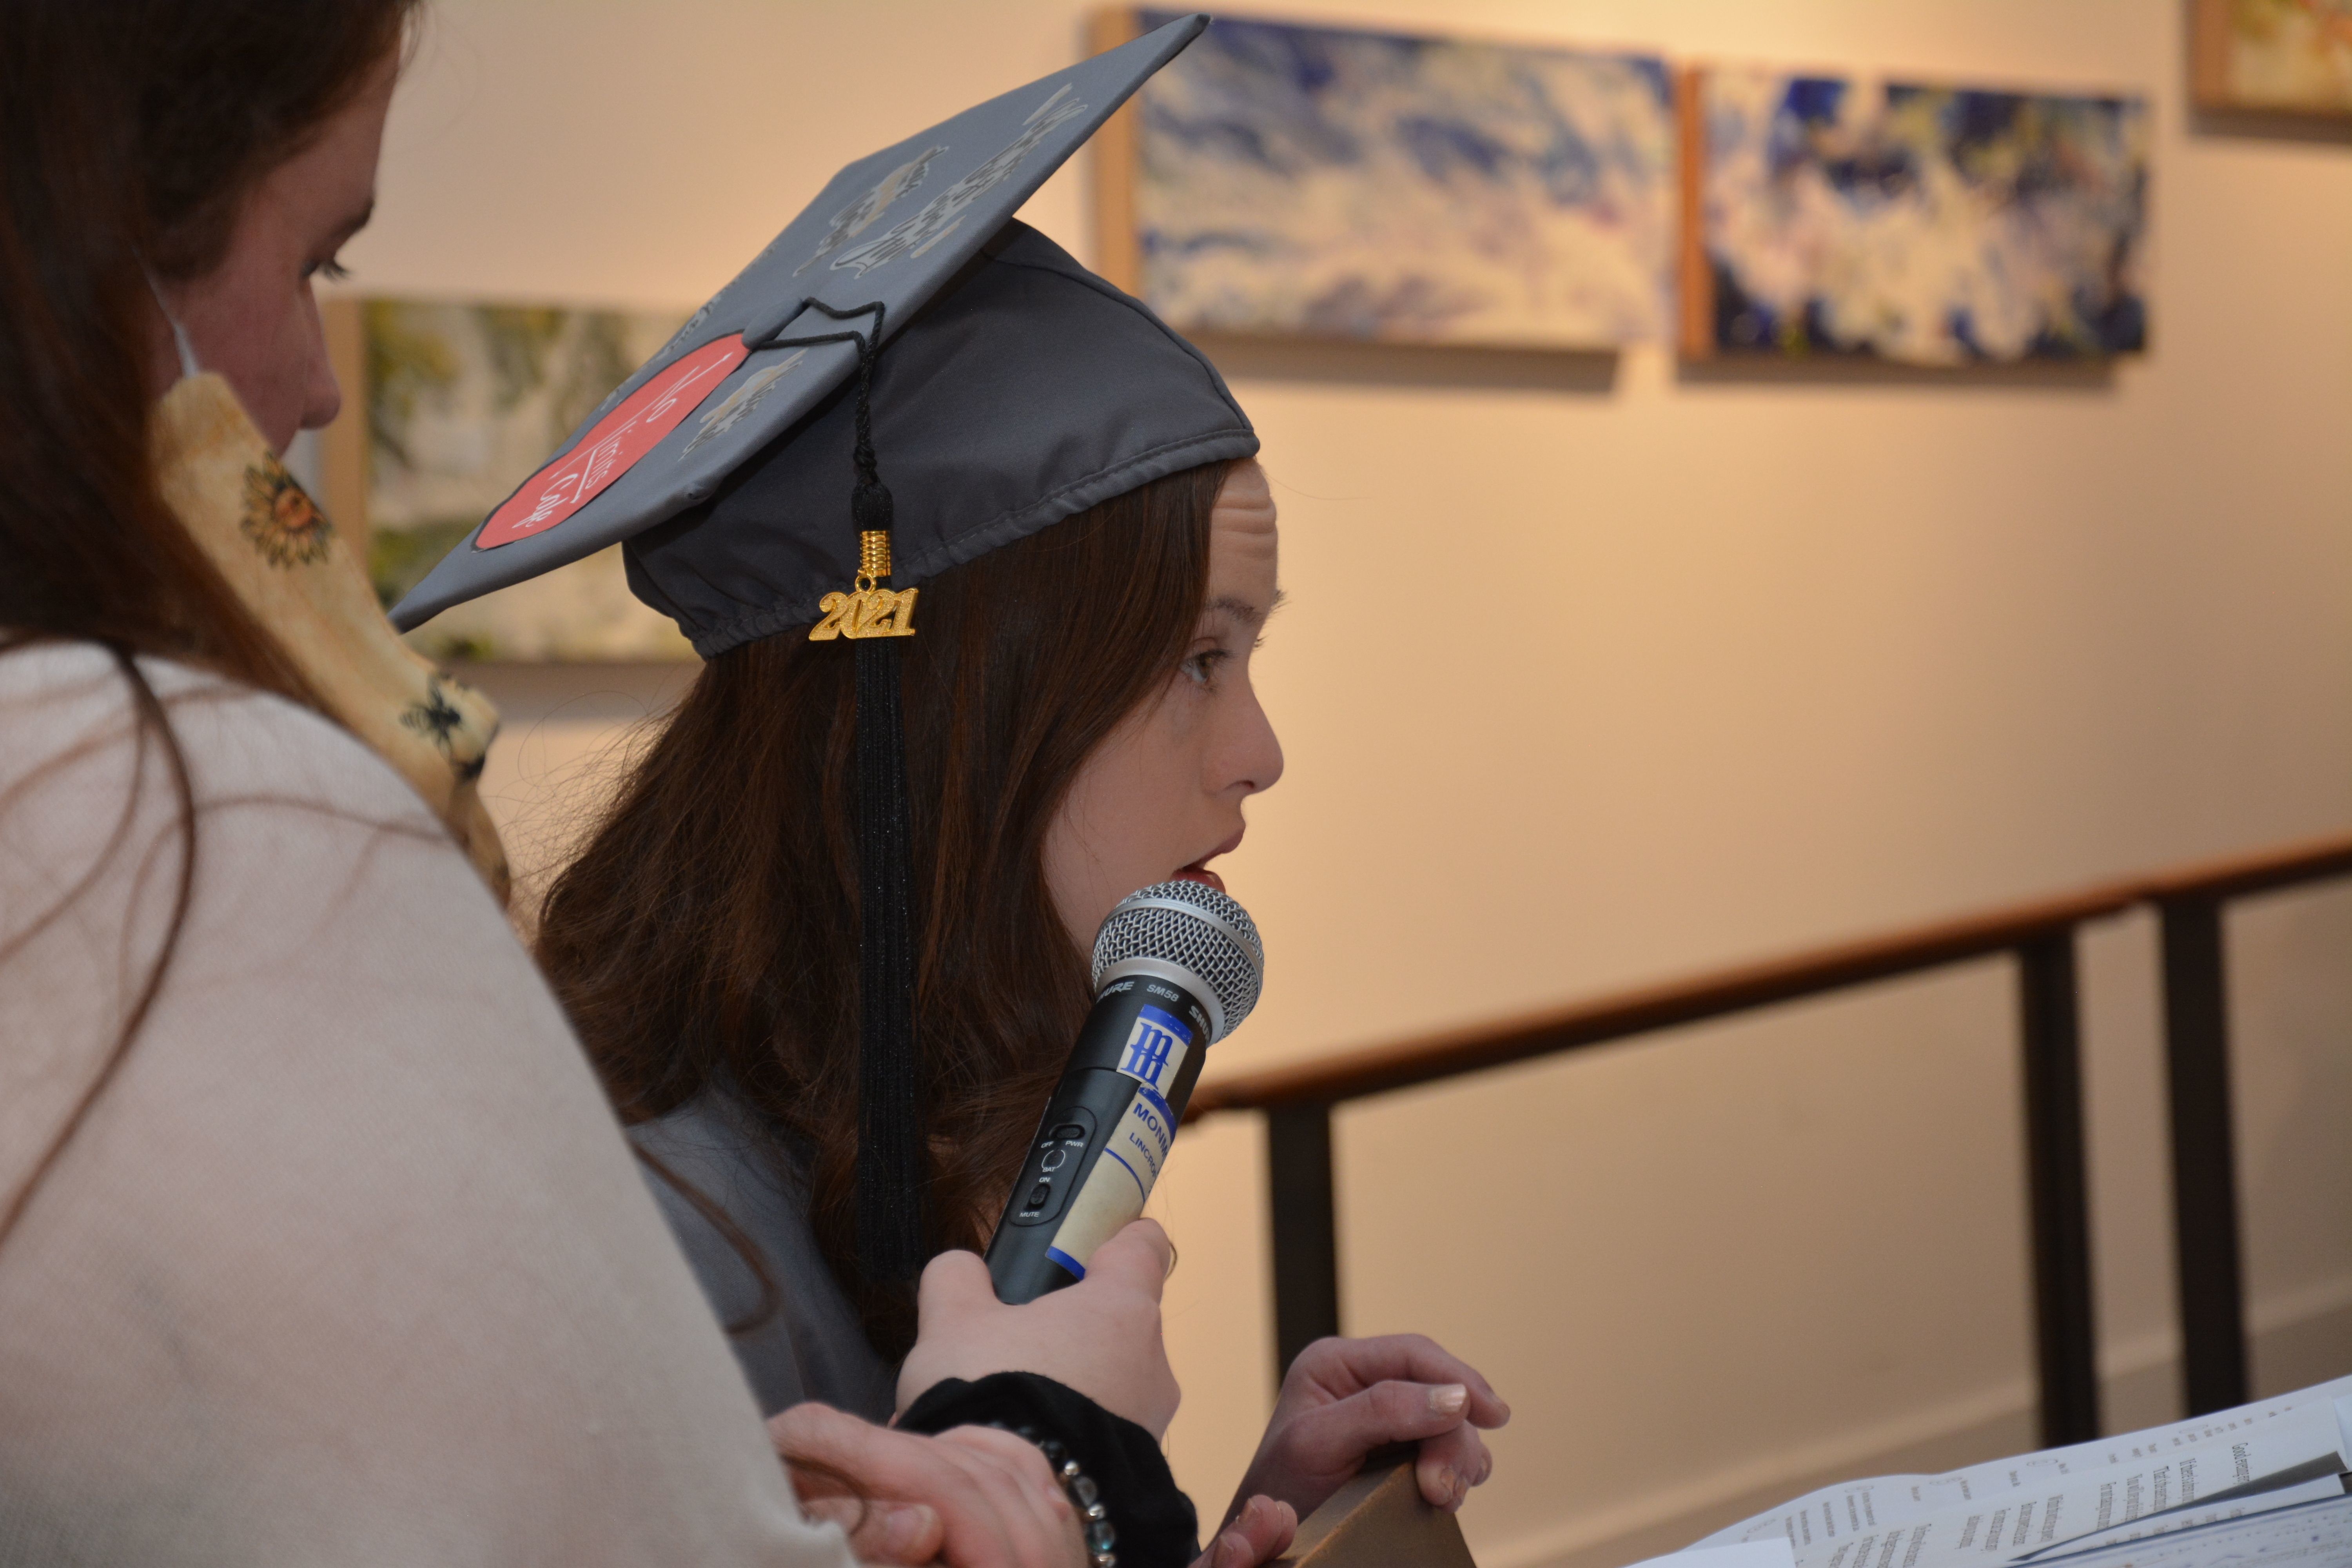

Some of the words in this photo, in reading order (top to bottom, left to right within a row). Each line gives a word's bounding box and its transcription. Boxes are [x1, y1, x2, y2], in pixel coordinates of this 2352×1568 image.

[570, 421, 637, 504] Limits
[808, 588, 919, 641] 2021
[1147, 984, 1179, 1002] SM58
[1189, 1005, 1210, 1046] SHUR
[1133, 1102, 1168, 1158] MONM
[2232, 1443, 2251, 1459] Good
